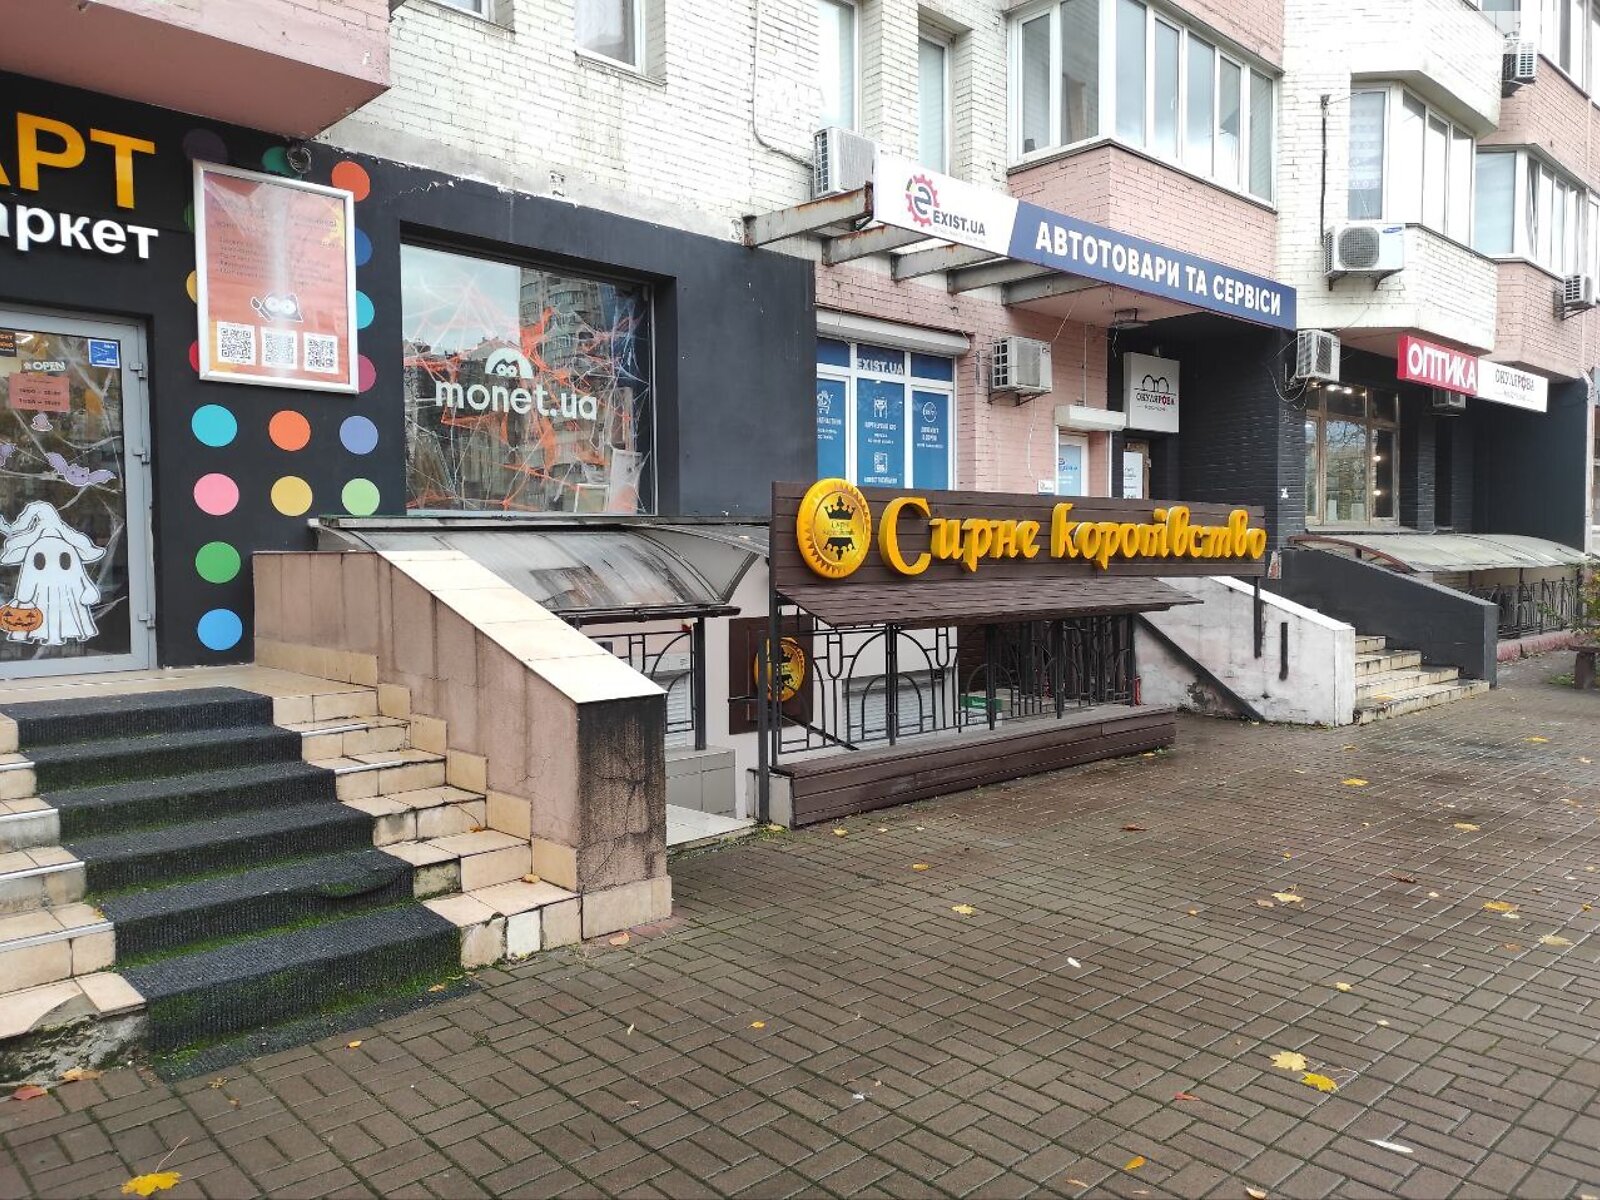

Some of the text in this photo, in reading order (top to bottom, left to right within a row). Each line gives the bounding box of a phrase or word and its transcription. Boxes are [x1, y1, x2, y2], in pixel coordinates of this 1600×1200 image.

[0, 112, 156, 209] РТ
[0, 202, 159, 259] ркет
[933, 209, 986, 237] EXIST.UA
[1035, 221, 1180, 288] АВТОТОВАРИ
[1185, 265, 1209, 297] ТА
[1212, 275, 1282, 317] СЕРВІСИ
[32, 361, 66, 372] OPEN
[857, 358, 904, 376] EXIST.UA
[1408, 342, 1478, 393] ОПТИКА
[435, 380, 598, 421] monet.ua
[878, 497, 1041, 576] Сирне
